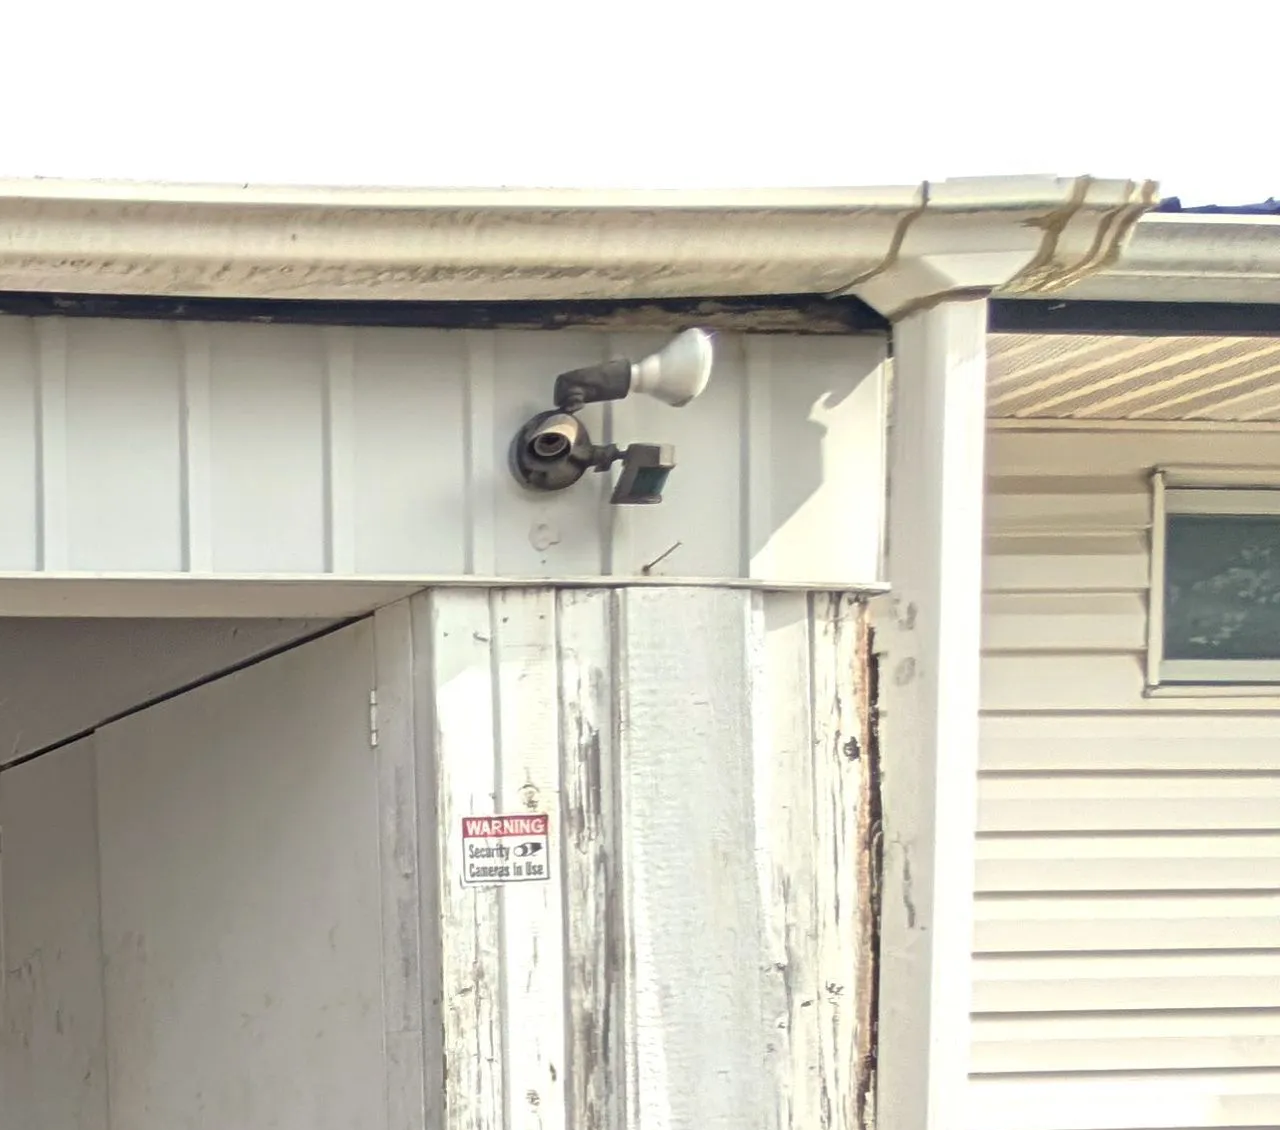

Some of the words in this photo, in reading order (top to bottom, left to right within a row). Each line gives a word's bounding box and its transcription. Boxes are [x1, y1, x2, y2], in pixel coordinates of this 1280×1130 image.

[466, 818, 545, 836] WARNING
[468, 843, 510, 862] Security
[469, 863, 510, 878] Cameras
[525, 861, 544, 876] Use
